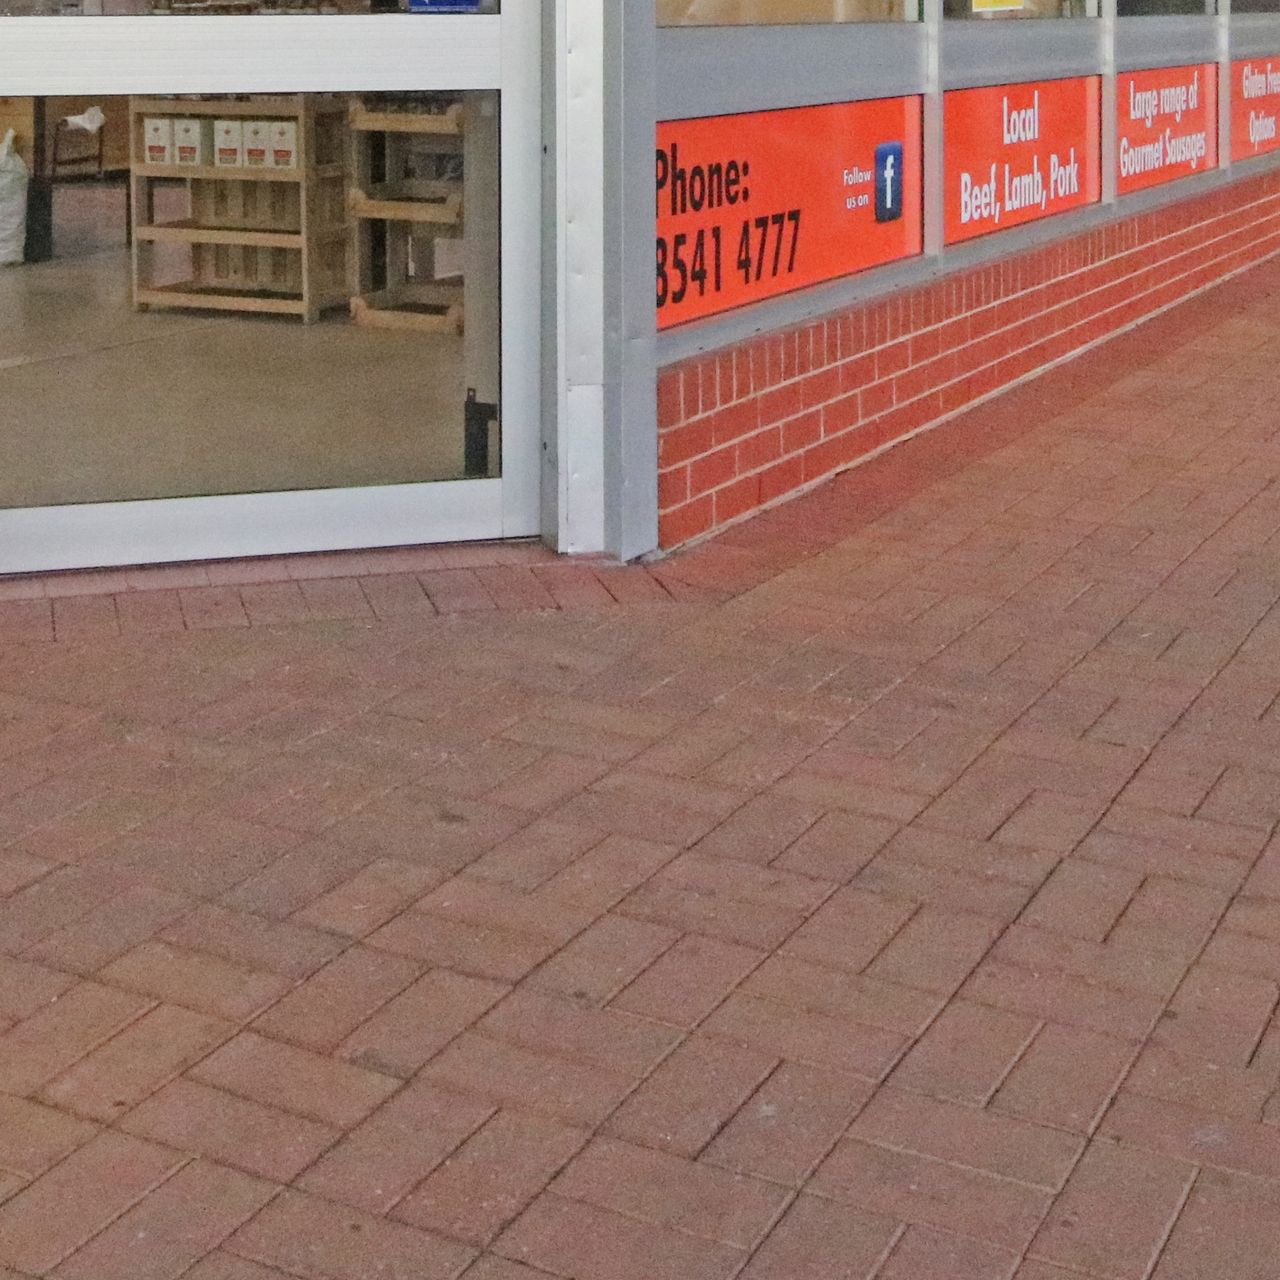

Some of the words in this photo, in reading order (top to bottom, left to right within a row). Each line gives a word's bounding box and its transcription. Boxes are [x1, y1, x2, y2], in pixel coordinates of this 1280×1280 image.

[1129, 80, 1158, 128] Large
[1160, 84, 1188, 123] range
[1187, 70, 1200, 111] of
[1242, 63, 1268, 100] Gluten
[1002, 89, 1039, 145] Local
[1249, 109, 1277, 152] Options
[656, 142, 749, 219] Phone:
[843, 166, 872, 187] Follow
[1120, 134, 1164, 178] Gourmet
[1164, 127, 1207, 170] Sausages
[960, 162, 1001, 225] Beef,
[1004, 154, 1047, 211] Lamb,
[1049, 146, 1079, 200] Pork
[656, 225, 721, 309] 8541
[737, 208, 801, 285] 4777
